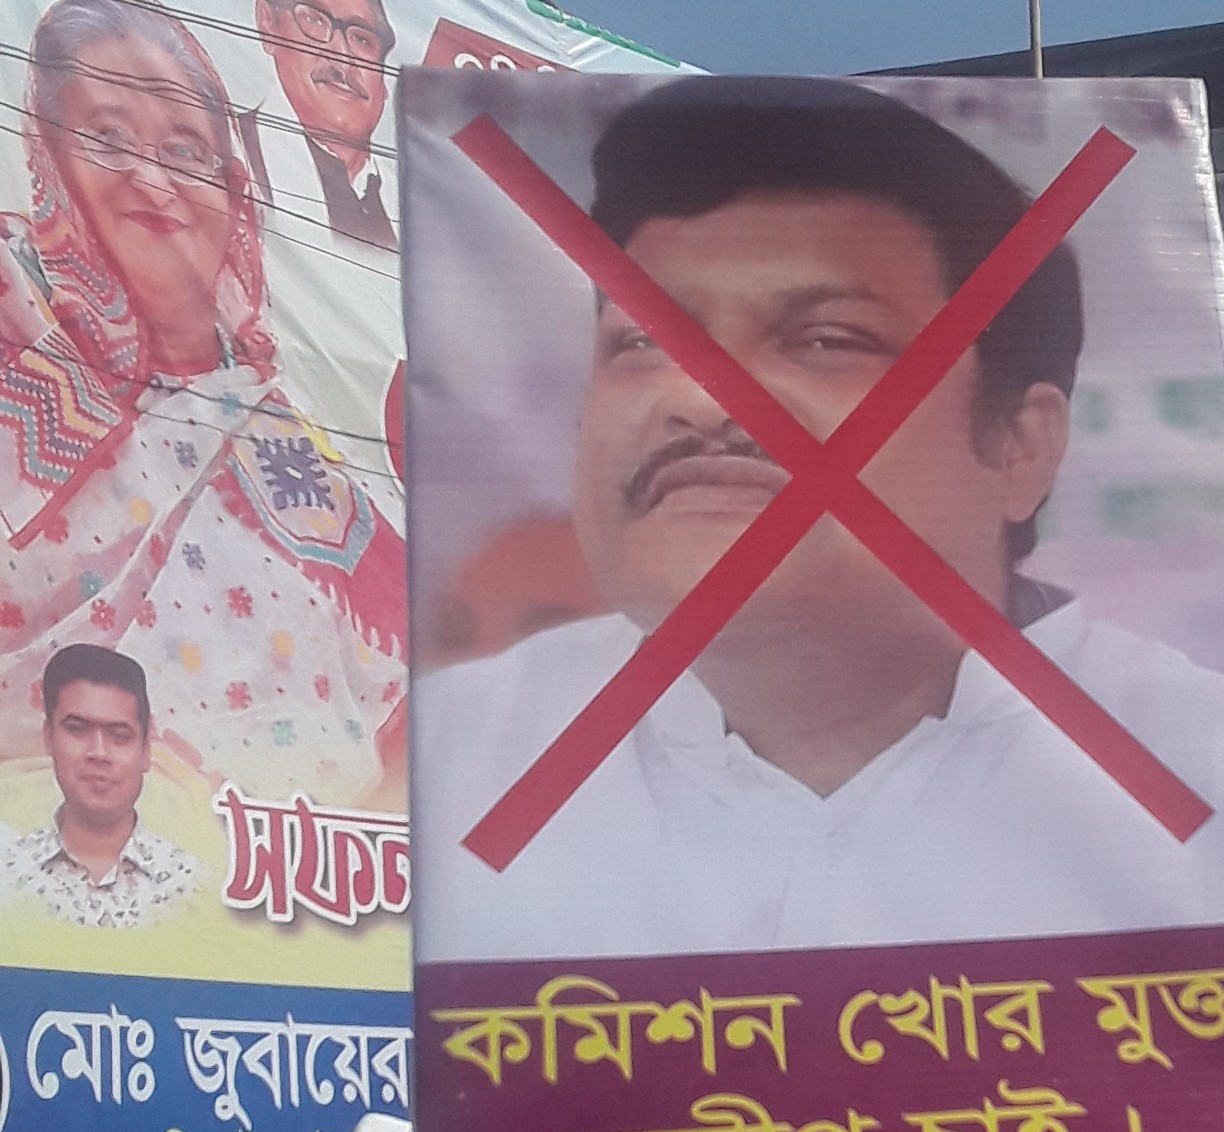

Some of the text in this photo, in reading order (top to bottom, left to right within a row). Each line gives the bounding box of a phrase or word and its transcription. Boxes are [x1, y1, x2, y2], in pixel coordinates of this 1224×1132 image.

[26, 1003, 413, 1131] মোঃ জুবায়ের
[430, 974, 800, 1085] কমিশন
[837, 973, 1055, 1065] খোর
